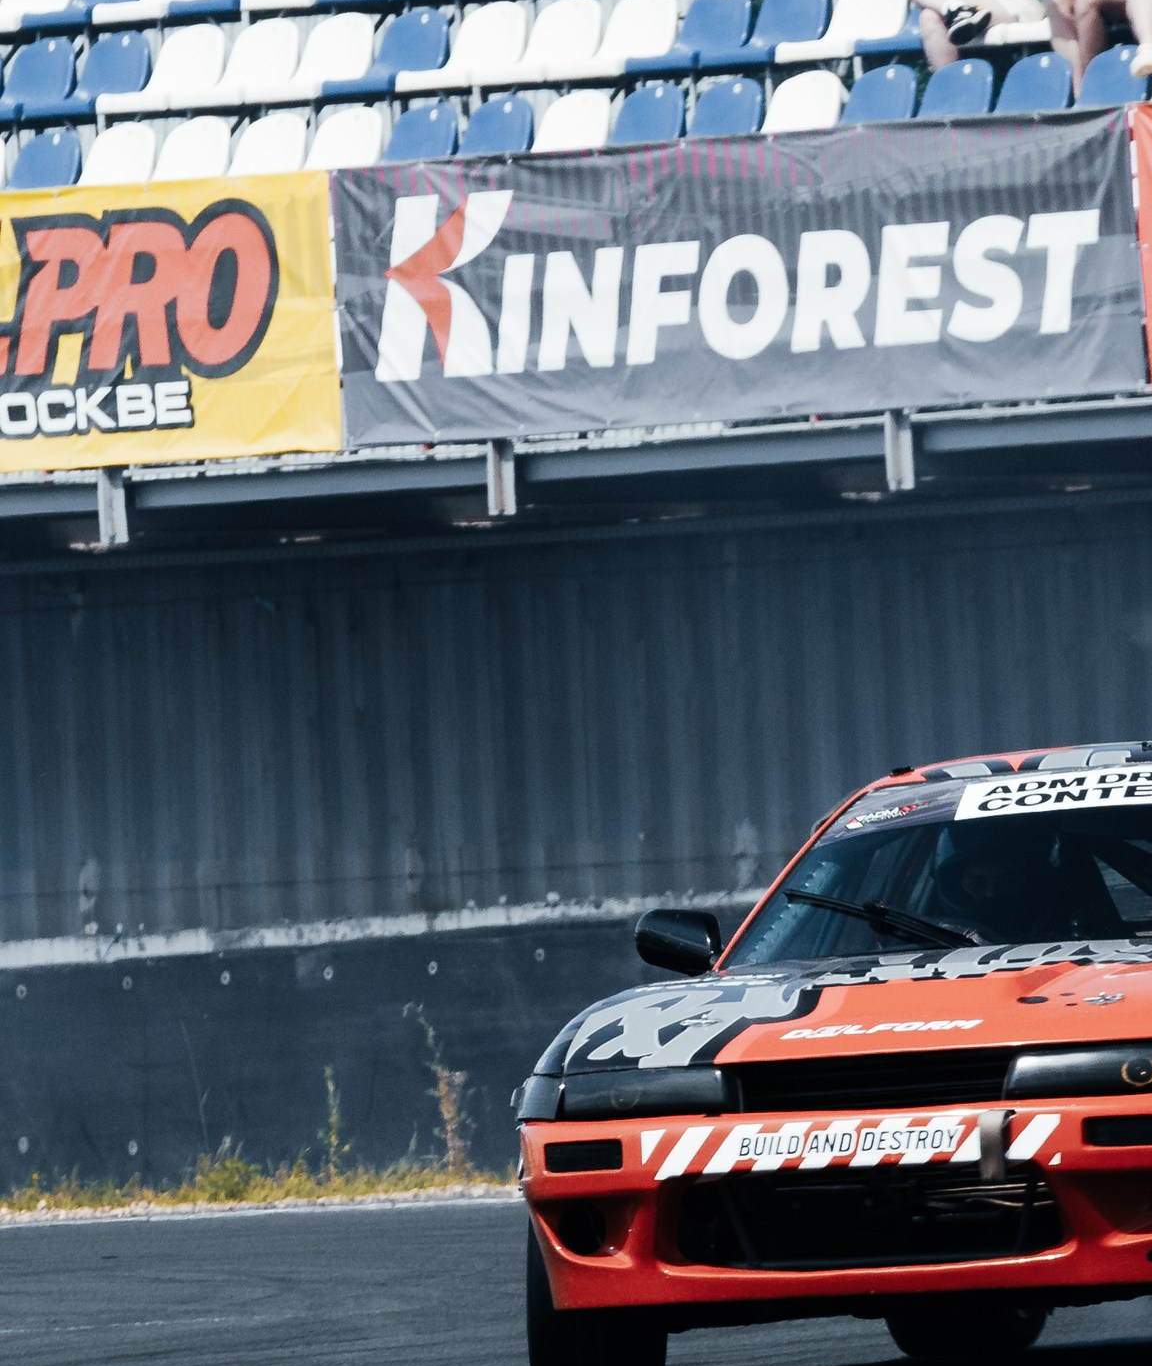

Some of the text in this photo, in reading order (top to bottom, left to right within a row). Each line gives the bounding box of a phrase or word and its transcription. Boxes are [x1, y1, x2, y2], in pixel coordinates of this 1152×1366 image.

[0, 201, 278, 377] PRO
[375, 190, 1099, 381] KINFOREST
[988, 776, 1087, 797] ADM
[738, 1124, 961, 1157] BUILD AND DESTROY
